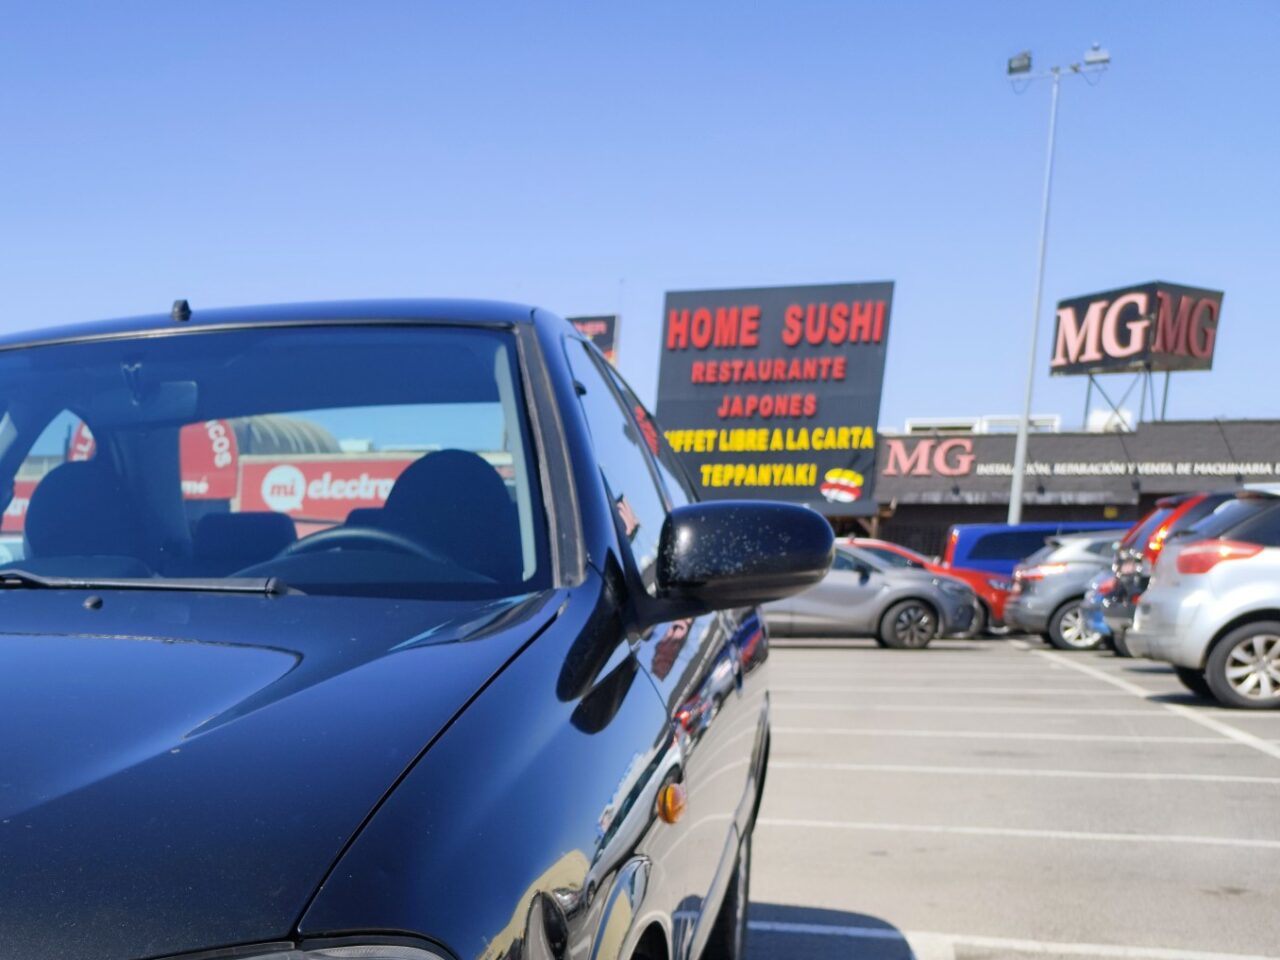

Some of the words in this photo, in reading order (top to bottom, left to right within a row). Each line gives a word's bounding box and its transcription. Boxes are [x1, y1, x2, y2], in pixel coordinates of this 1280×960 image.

[666, 305, 761, 349] HOME
[781, 300, 886, 346] SUSHI
[1051, 293, 1150, 366] MG
[1152, 290, 1220, 359] MG
[691, 356, 846, 383] RESTAURANTE
[717, 394, 817, 418] JAPONES
[719, 429, 768, 451] LIBRE
[769, 428, 784, 451] A
[785, 427, 810, 450] LA
[811, 426, 875, 449] CARTA
[882, 438, 976, 477] MG
[1127, 462, 1137, 475] Y
[1137, 462, 1171, 475] VENTA
[1176, 462, 1193, 475] DE
[269, 477, 297, 497] mi
[700, 463, 817, 486] TEPPANYAKI
